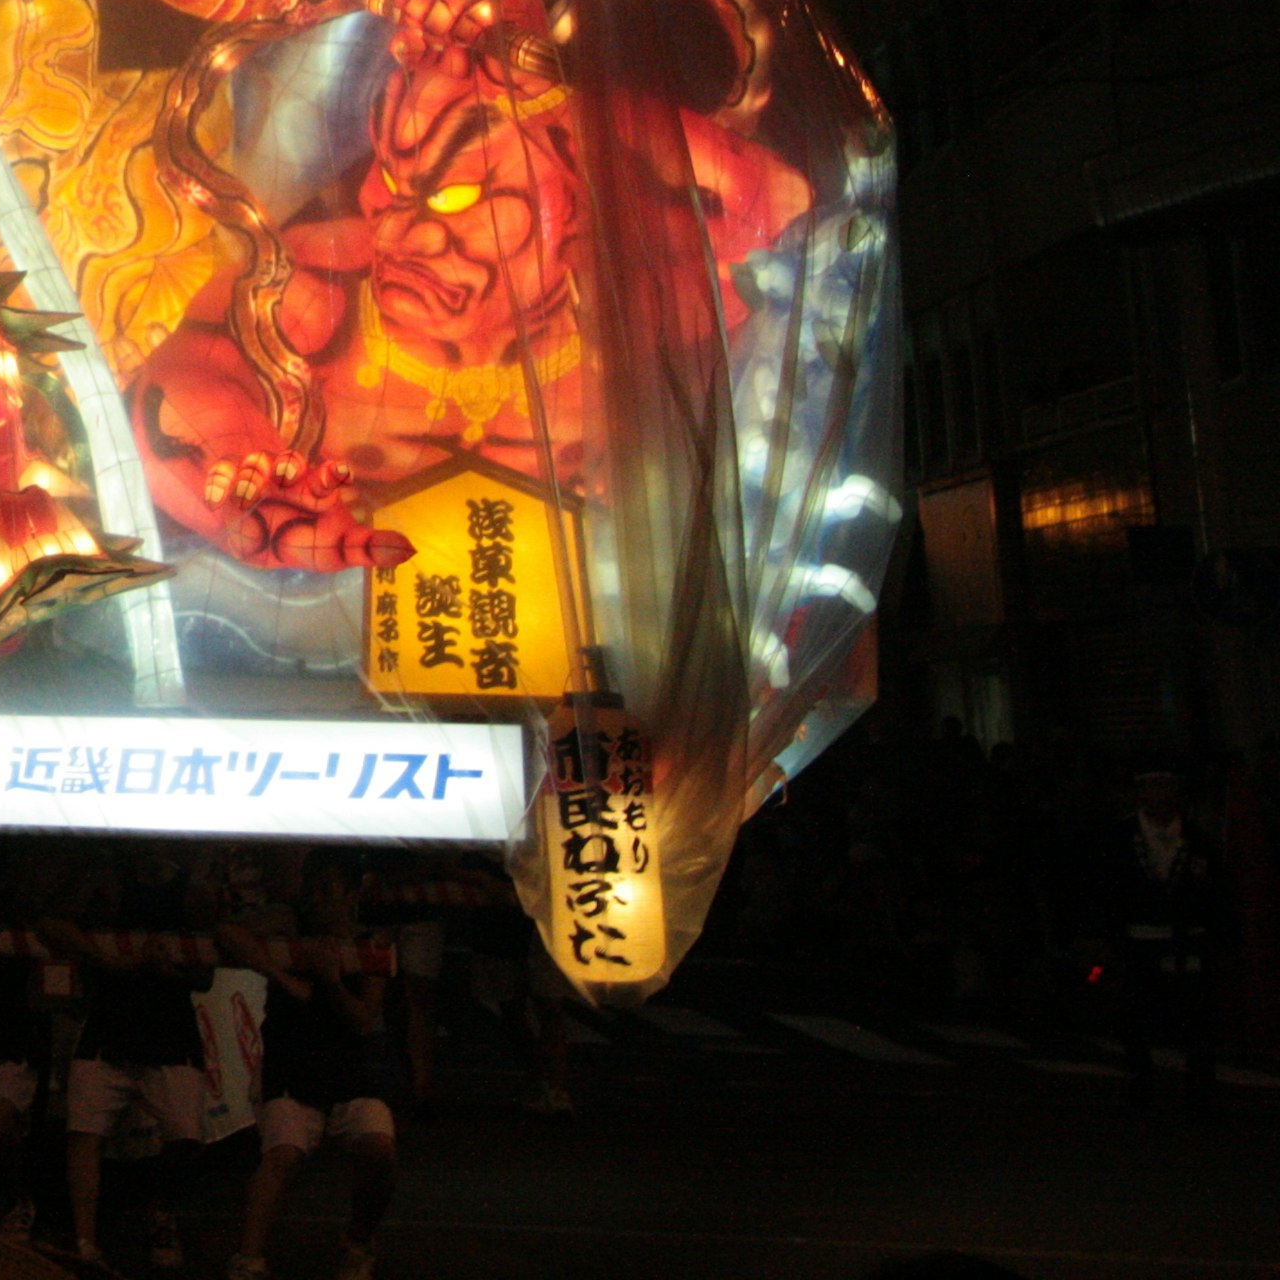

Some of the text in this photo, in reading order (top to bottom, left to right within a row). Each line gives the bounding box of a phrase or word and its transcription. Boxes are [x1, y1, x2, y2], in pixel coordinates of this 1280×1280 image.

[4, 745, 484, 801] 近畿日本ツーリスト
[552, 726, 632, 967] 市民ねぶた
[617, 726, 650, 874] あおもり
